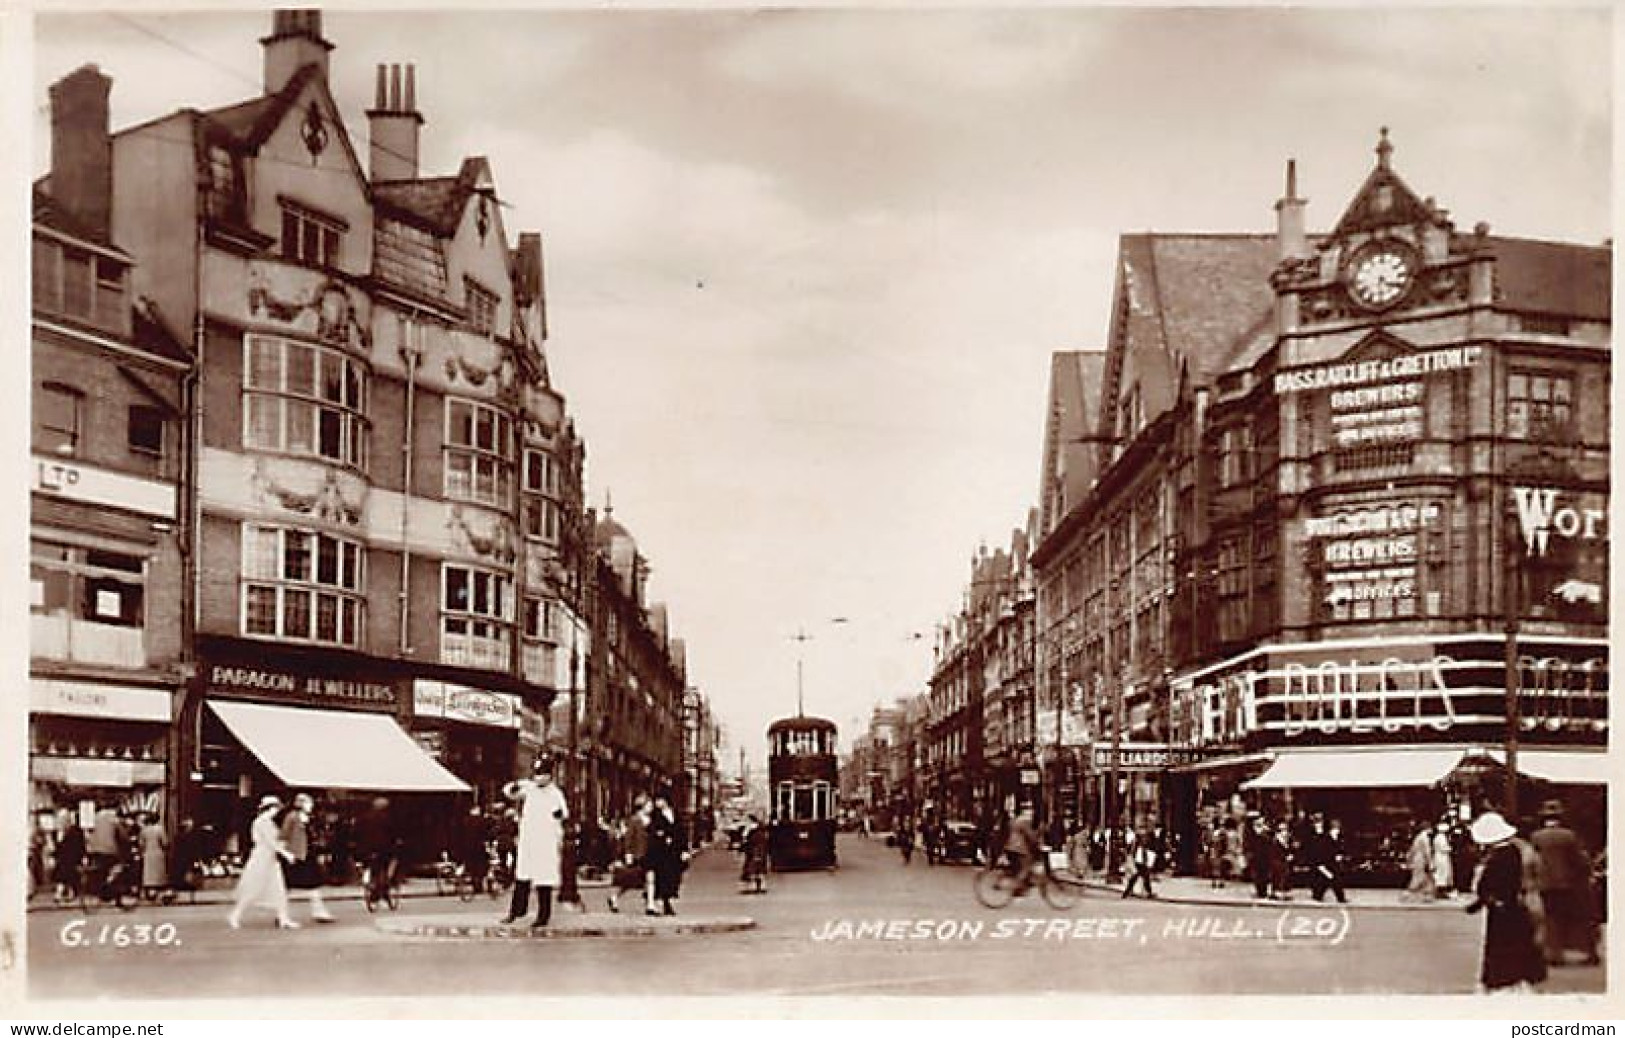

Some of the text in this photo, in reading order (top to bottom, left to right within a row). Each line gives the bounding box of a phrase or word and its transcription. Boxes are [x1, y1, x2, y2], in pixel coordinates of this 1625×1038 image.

[212, 665, 295, 692] PARAGON
[1284, 657, 1456, 737] DOLCIS
[1096, 751, 1166, 765] BILIARDS
